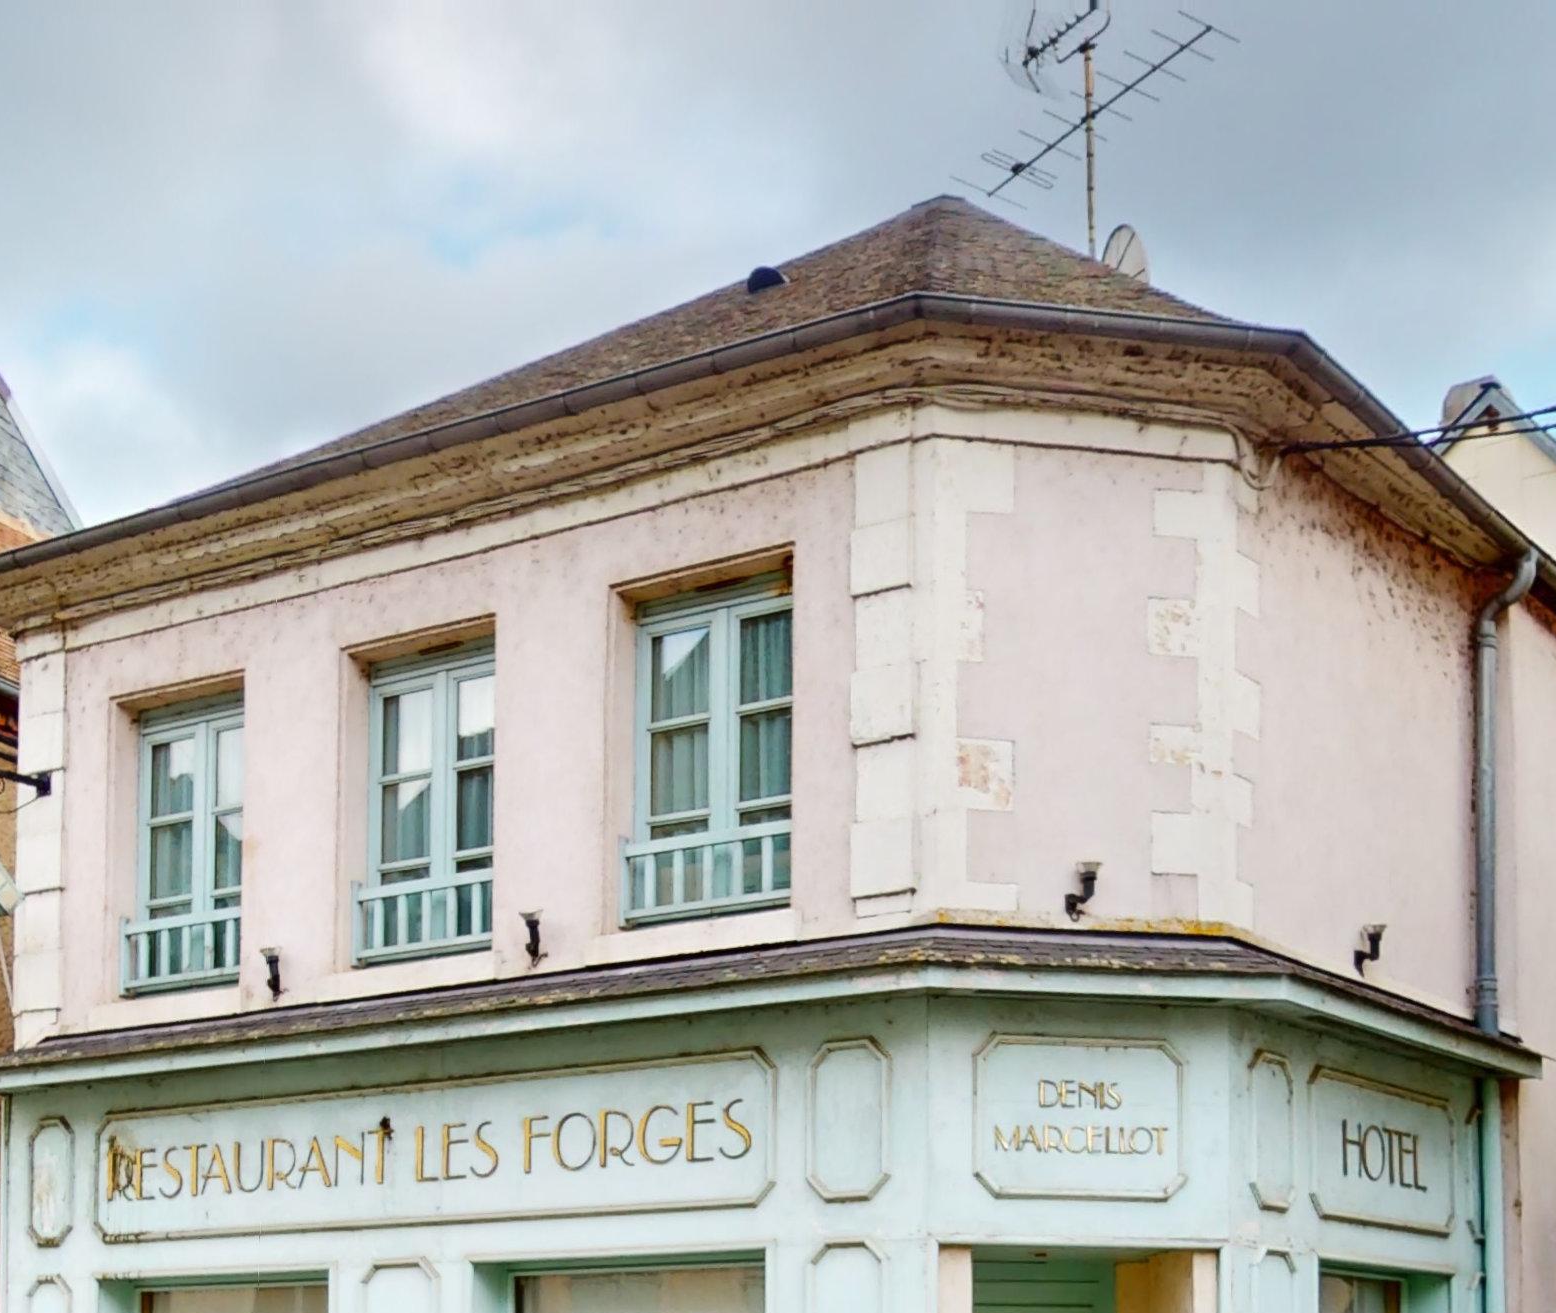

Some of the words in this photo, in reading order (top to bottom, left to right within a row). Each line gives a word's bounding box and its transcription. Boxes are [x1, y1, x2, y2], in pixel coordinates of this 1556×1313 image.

[1037, 1079, 1123, 1111] DENIS
[106, 1127, 394, 1202] RESTAURANT
[415, 1119, 499, 1182] LES
[522, 1098, 753, 1175] FORGES
[993, 1124, 1169, 1155] MARCELLOT
[1341, 1118, 1429, 1193] HOTEL
